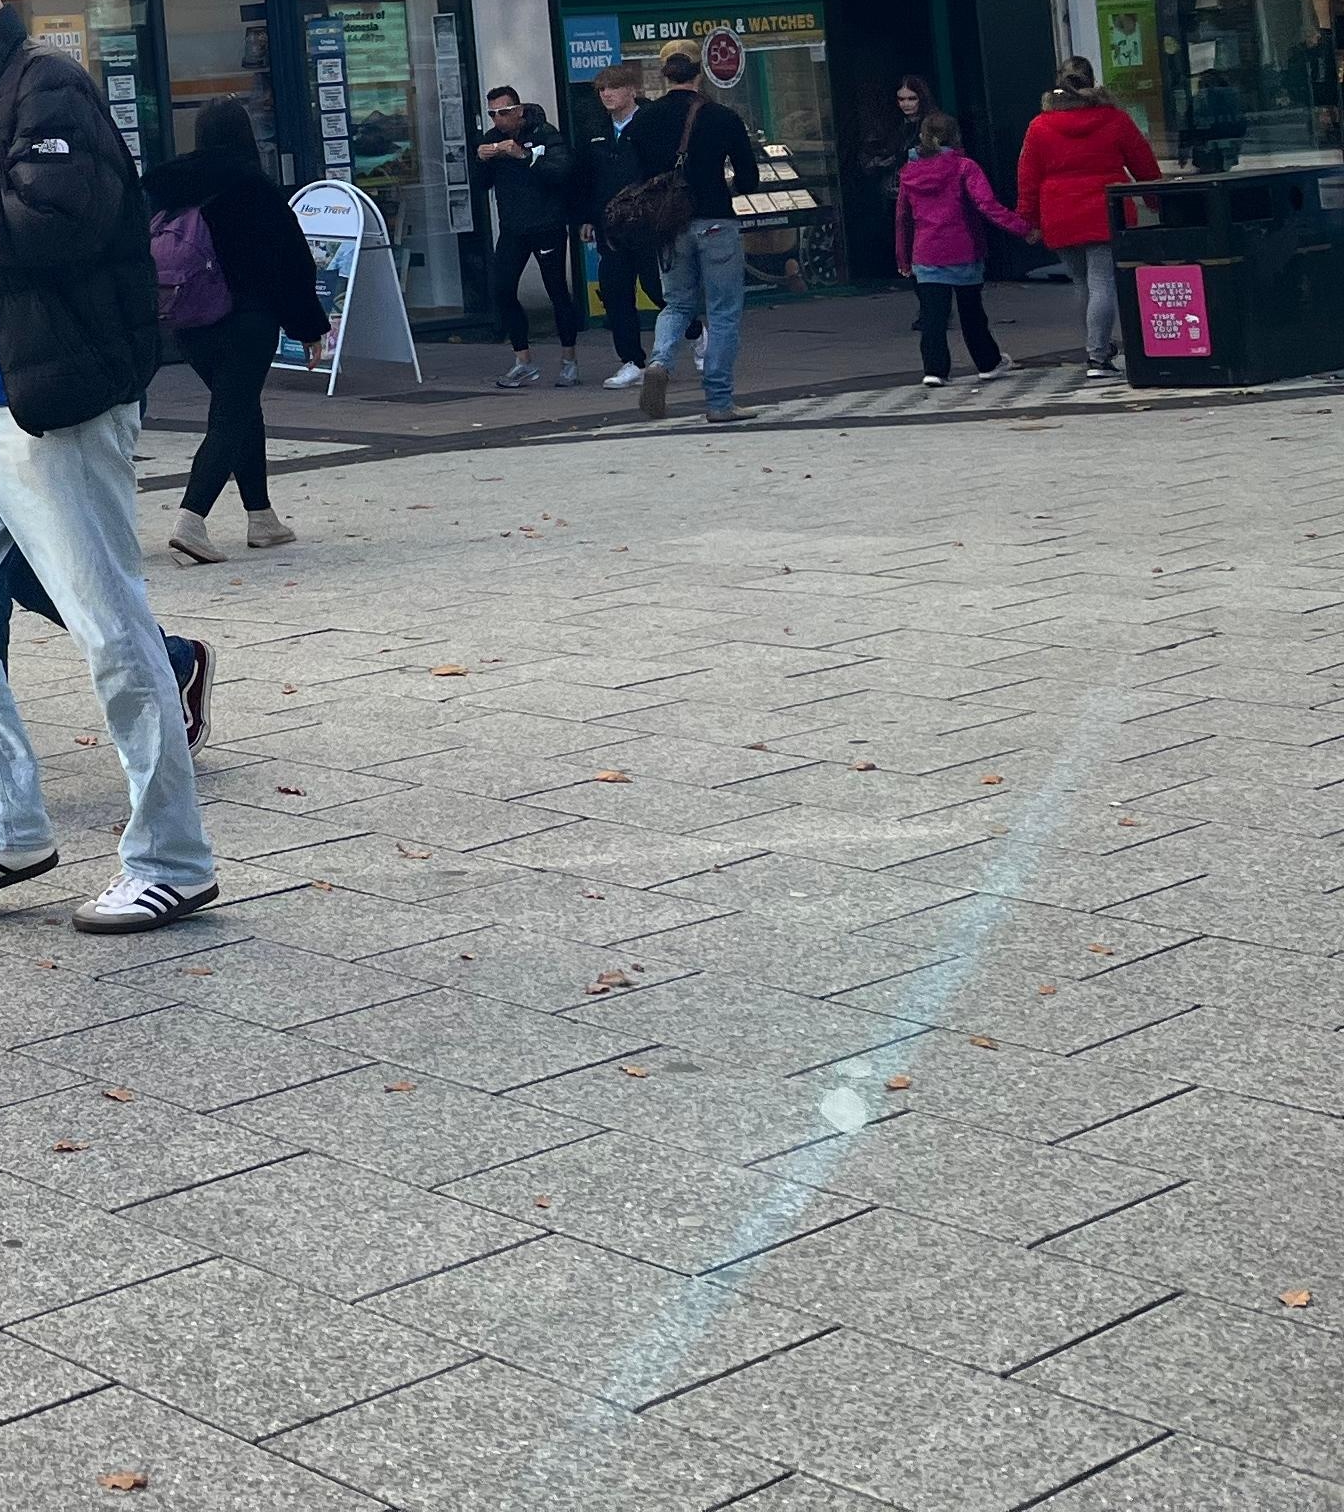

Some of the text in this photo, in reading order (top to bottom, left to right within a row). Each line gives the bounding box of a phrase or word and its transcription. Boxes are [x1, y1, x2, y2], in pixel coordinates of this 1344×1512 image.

[633, 23, 656, 40] WE
[659, 21, 689, 38] BUY
[735, 18, 745, 33] &
[747, 13, 815, 32] WATCHES
[569, 39, 613, 53] TRAVEL
[571, 54, 613, 68] MONEY
[300, 203, 353, 215] Hays Travel
